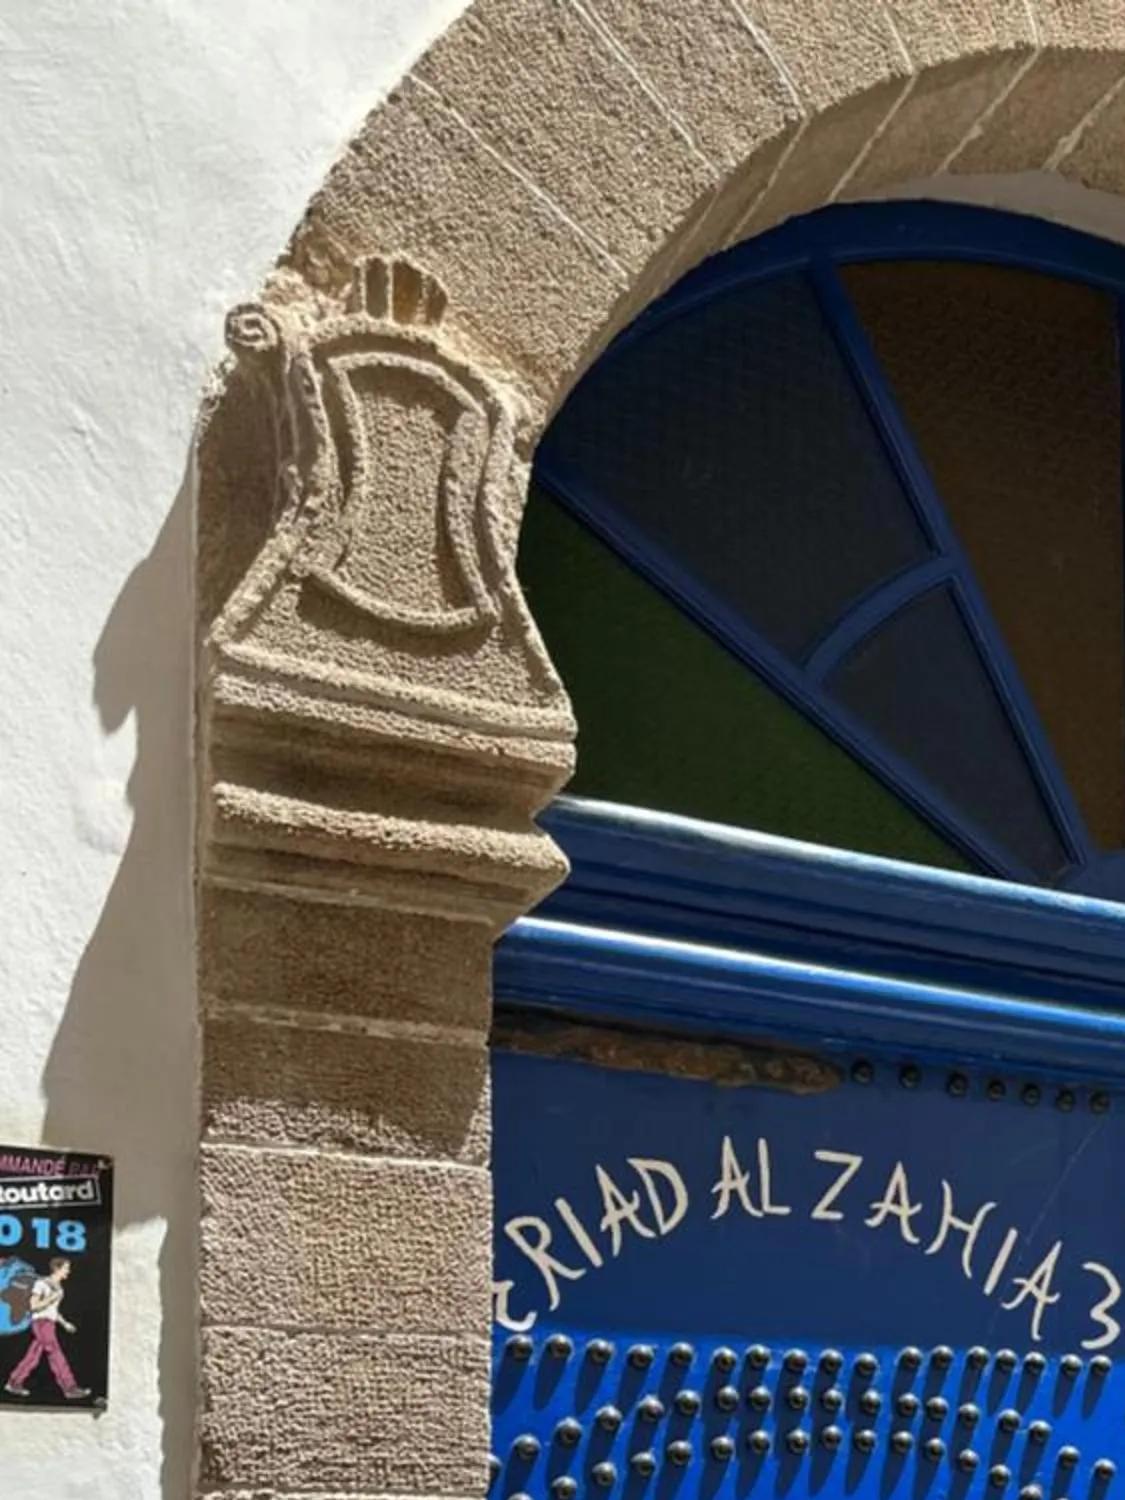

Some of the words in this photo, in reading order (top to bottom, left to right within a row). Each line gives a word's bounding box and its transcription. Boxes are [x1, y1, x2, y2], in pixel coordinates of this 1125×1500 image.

[0, 1180, 95, 1203] outard
[504, 1157, 690, 1311] RIAD
[711, 1136, 791, 1219] AL
[811, 1150, 1062, 1342] ZAHIA
